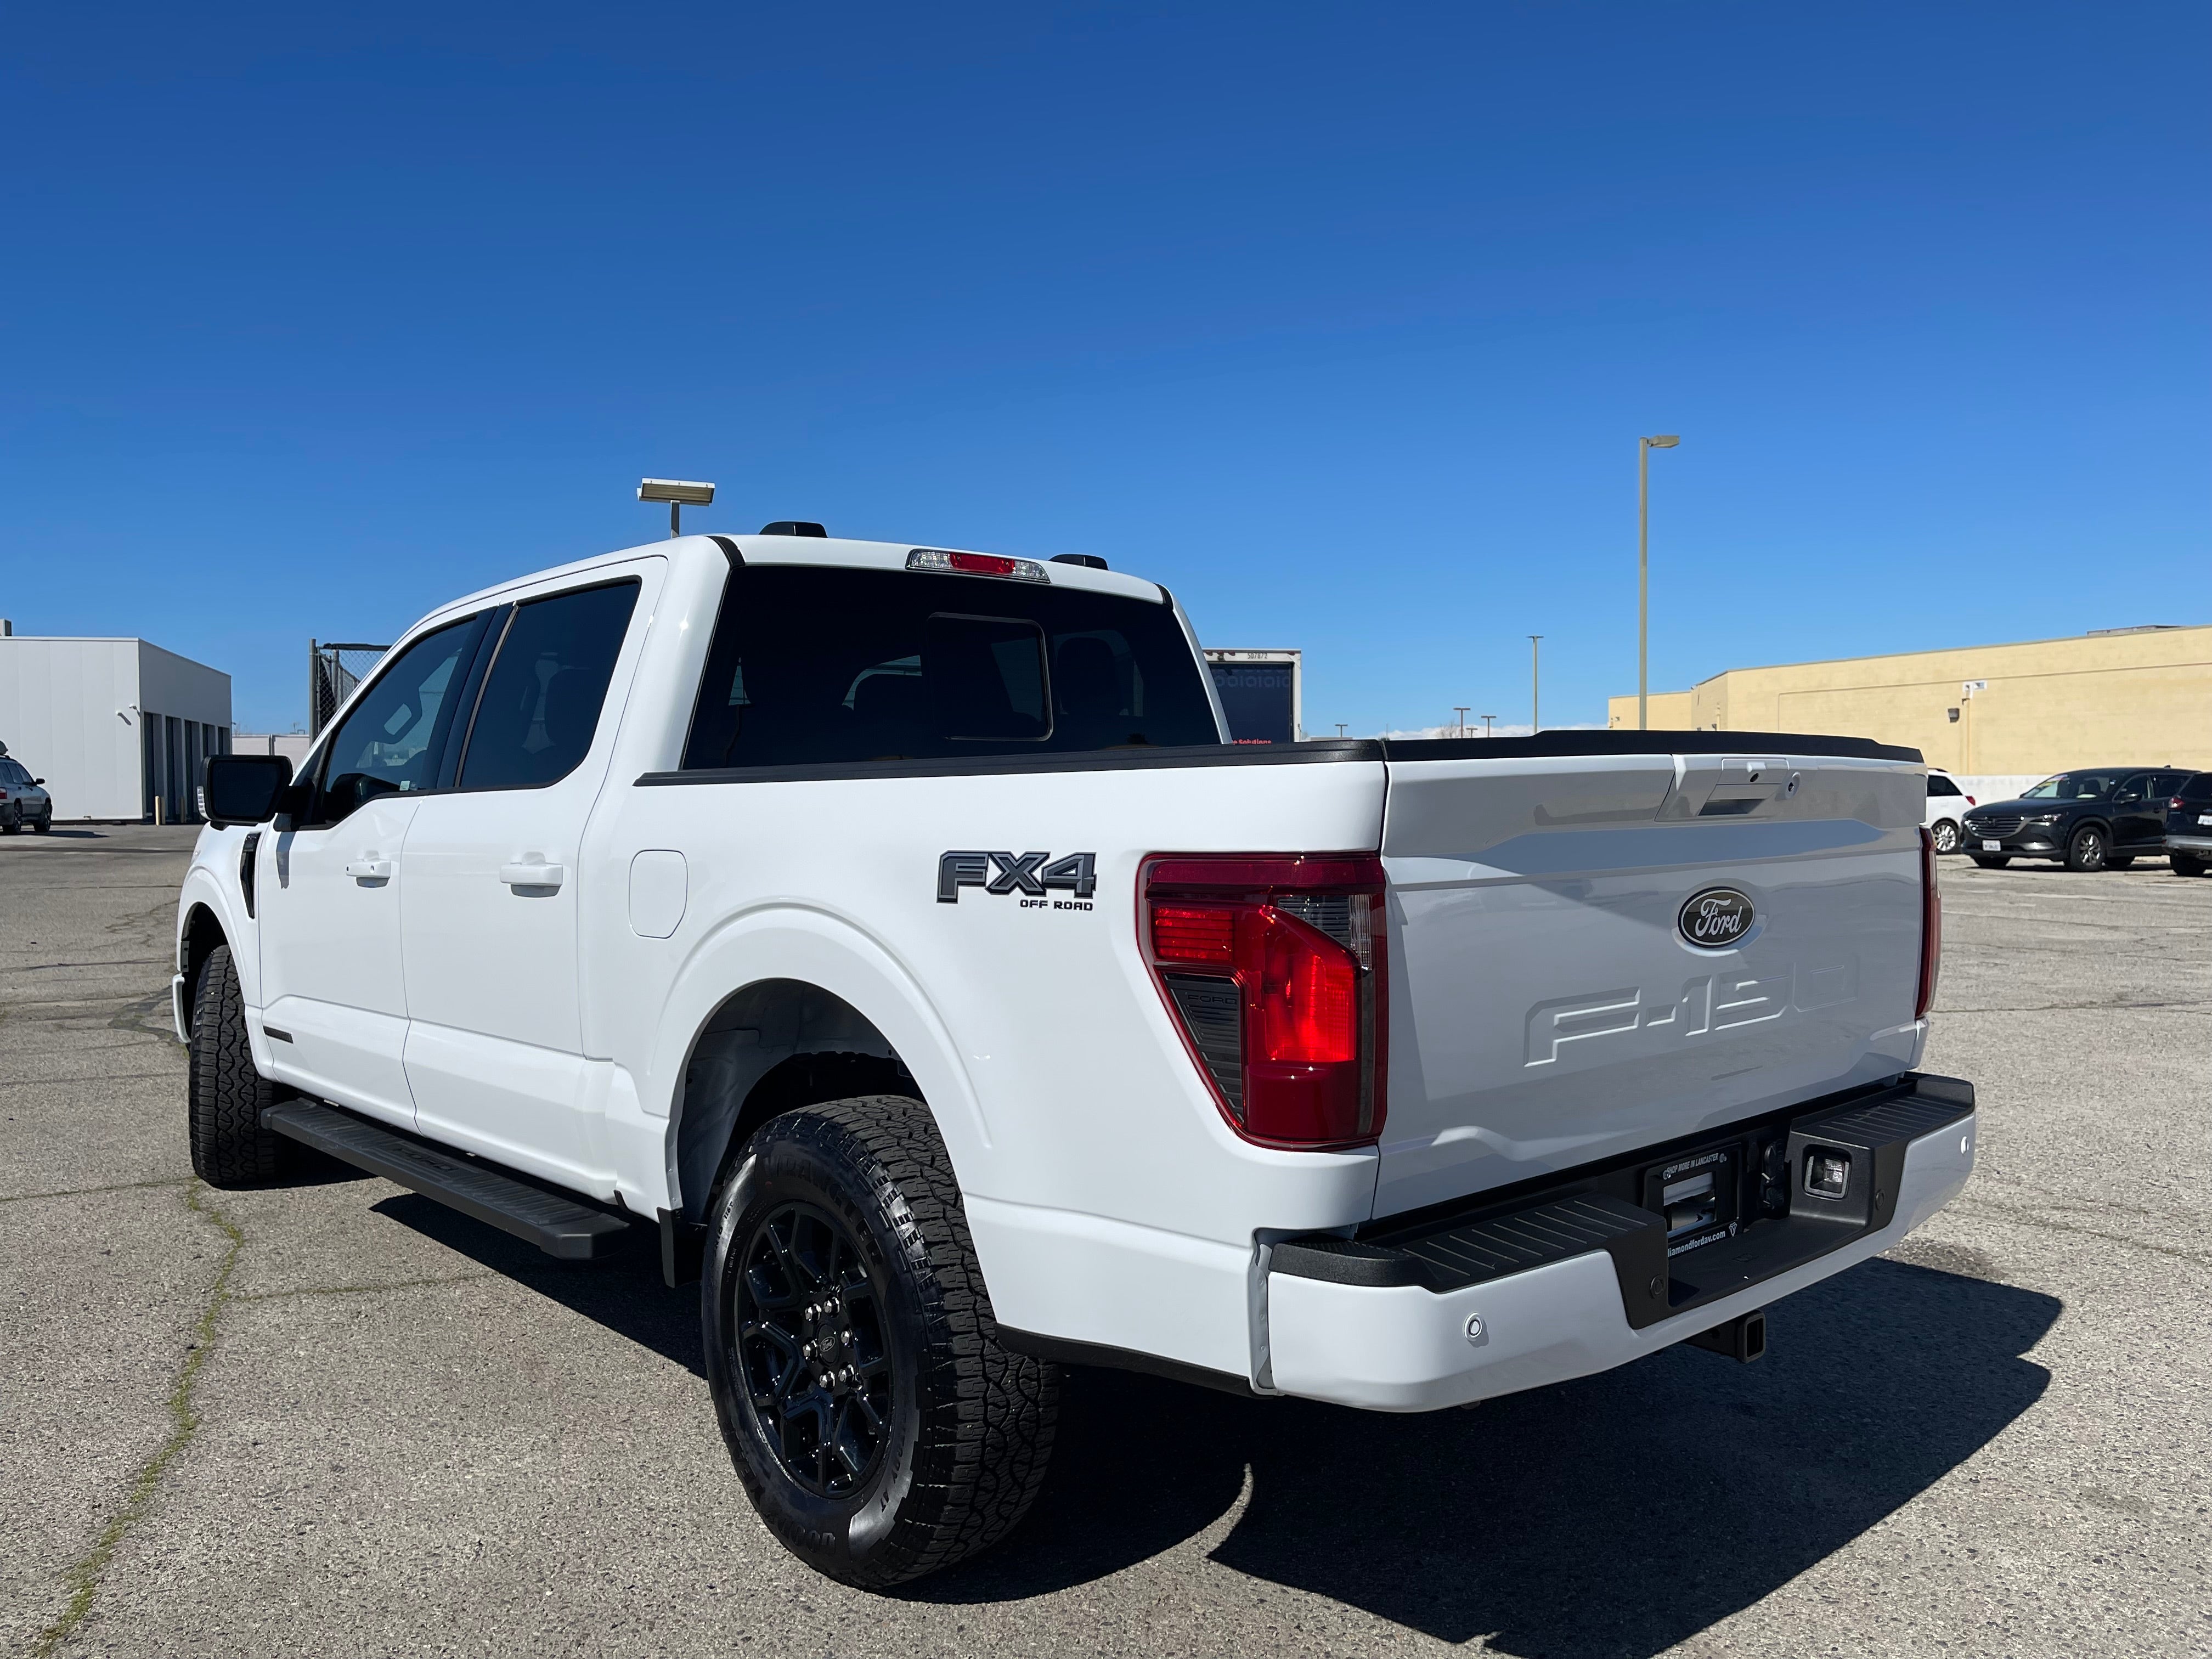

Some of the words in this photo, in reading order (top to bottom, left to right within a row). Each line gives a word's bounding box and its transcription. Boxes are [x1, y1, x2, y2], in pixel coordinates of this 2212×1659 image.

[936, 850, 1097, 904] FX4
[1020, 899, 1048, 909] OFF
[1053, 900, 1093, 911] ROAD
[1695, 898, 1743, 937] Ford
[1188, 994, 1238, 1005] FORD
[1523, 956, 1861, 1068] F-150
[1678, 1161, 1690, 1172] MORE
[1690, 1159, 1696, 1168] IN
[1695, 1153, 1719, 1167] LANCASTER
